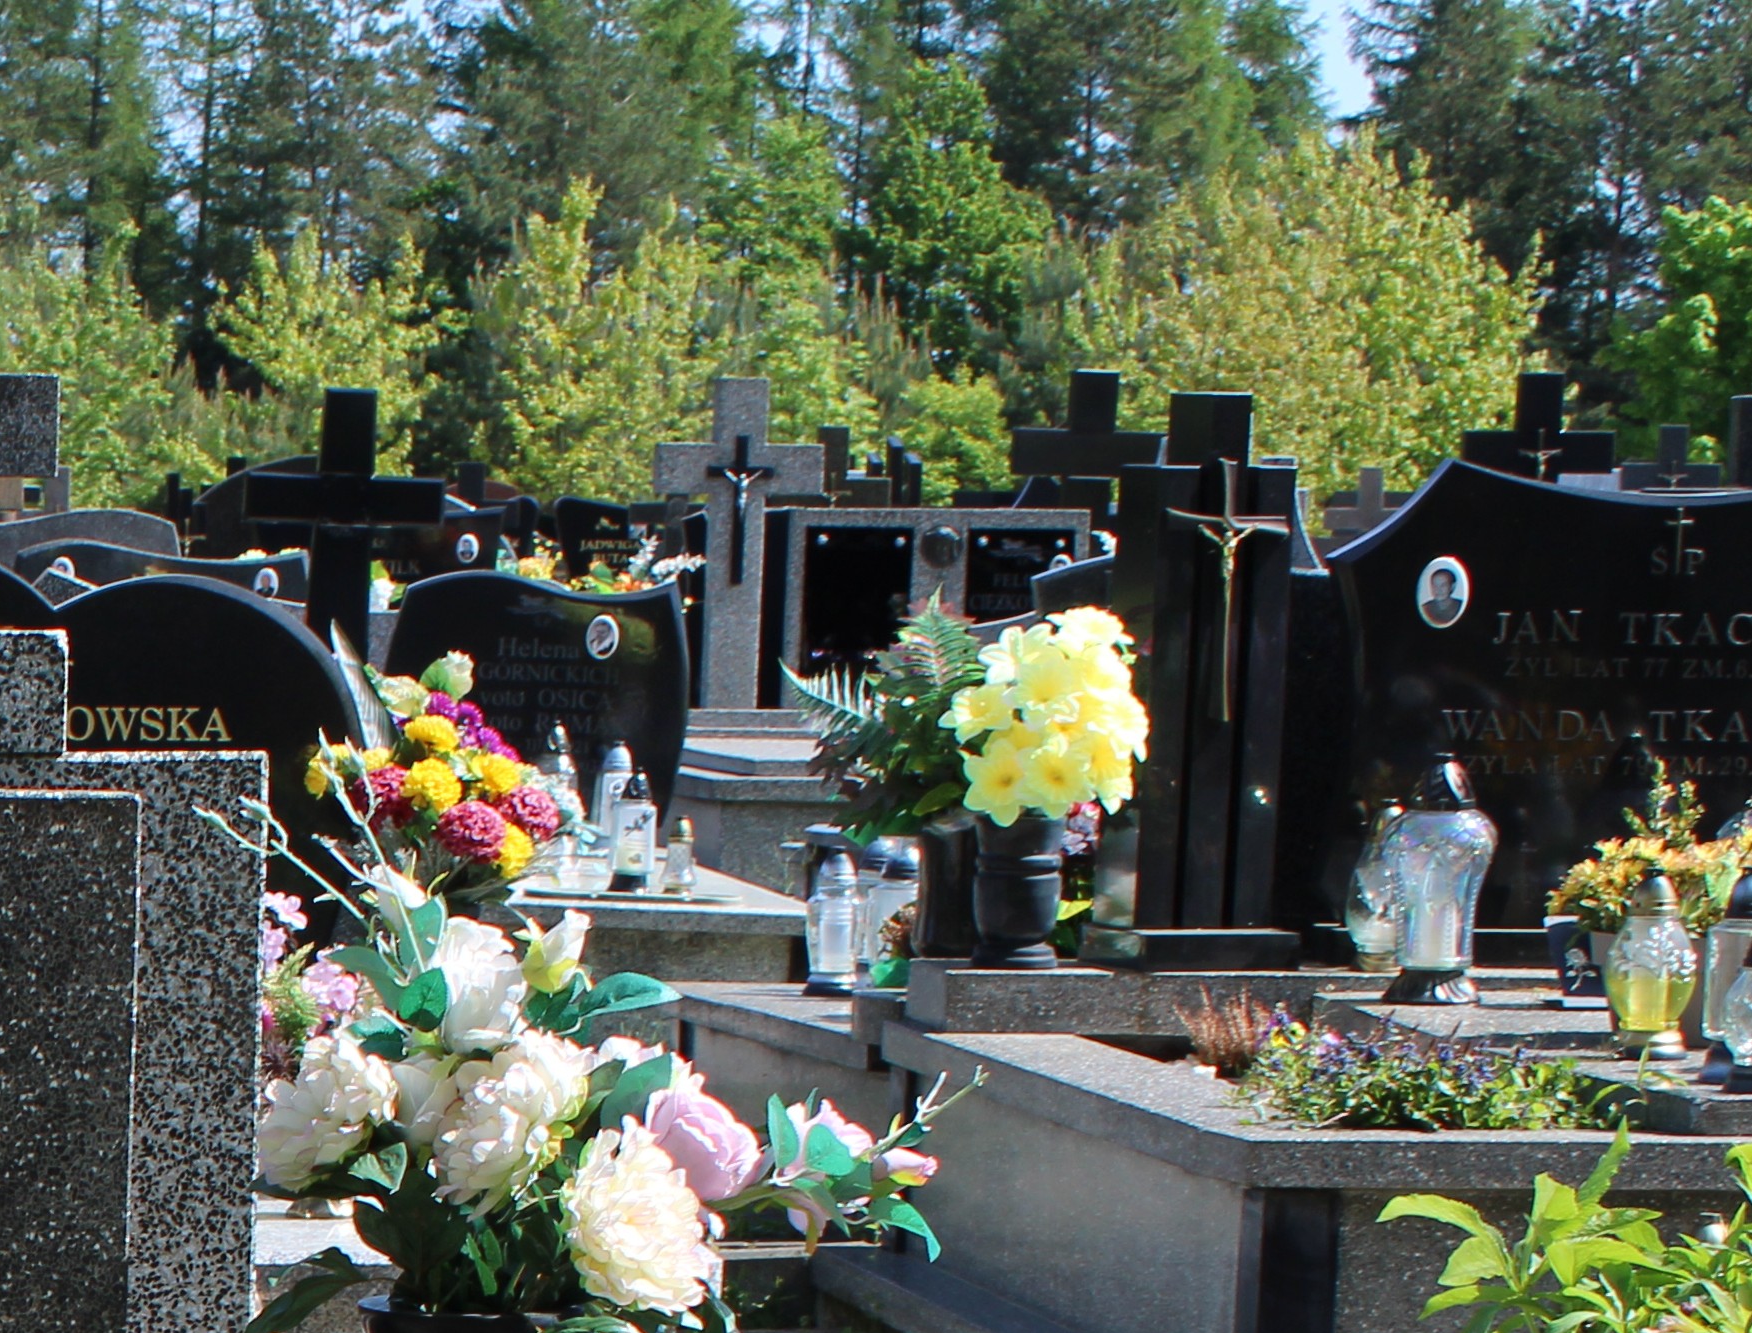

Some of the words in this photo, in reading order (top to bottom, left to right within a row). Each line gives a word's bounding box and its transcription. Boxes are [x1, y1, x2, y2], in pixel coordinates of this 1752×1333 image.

[1492, 609, 1584, 645] JAN
[497, 636, 580, 658] Helena
[1573, 657, 1630, 678] LAT
[67, 705, 233, 742] OWSKA
[1441, 709, 1615, 742] WANDA
